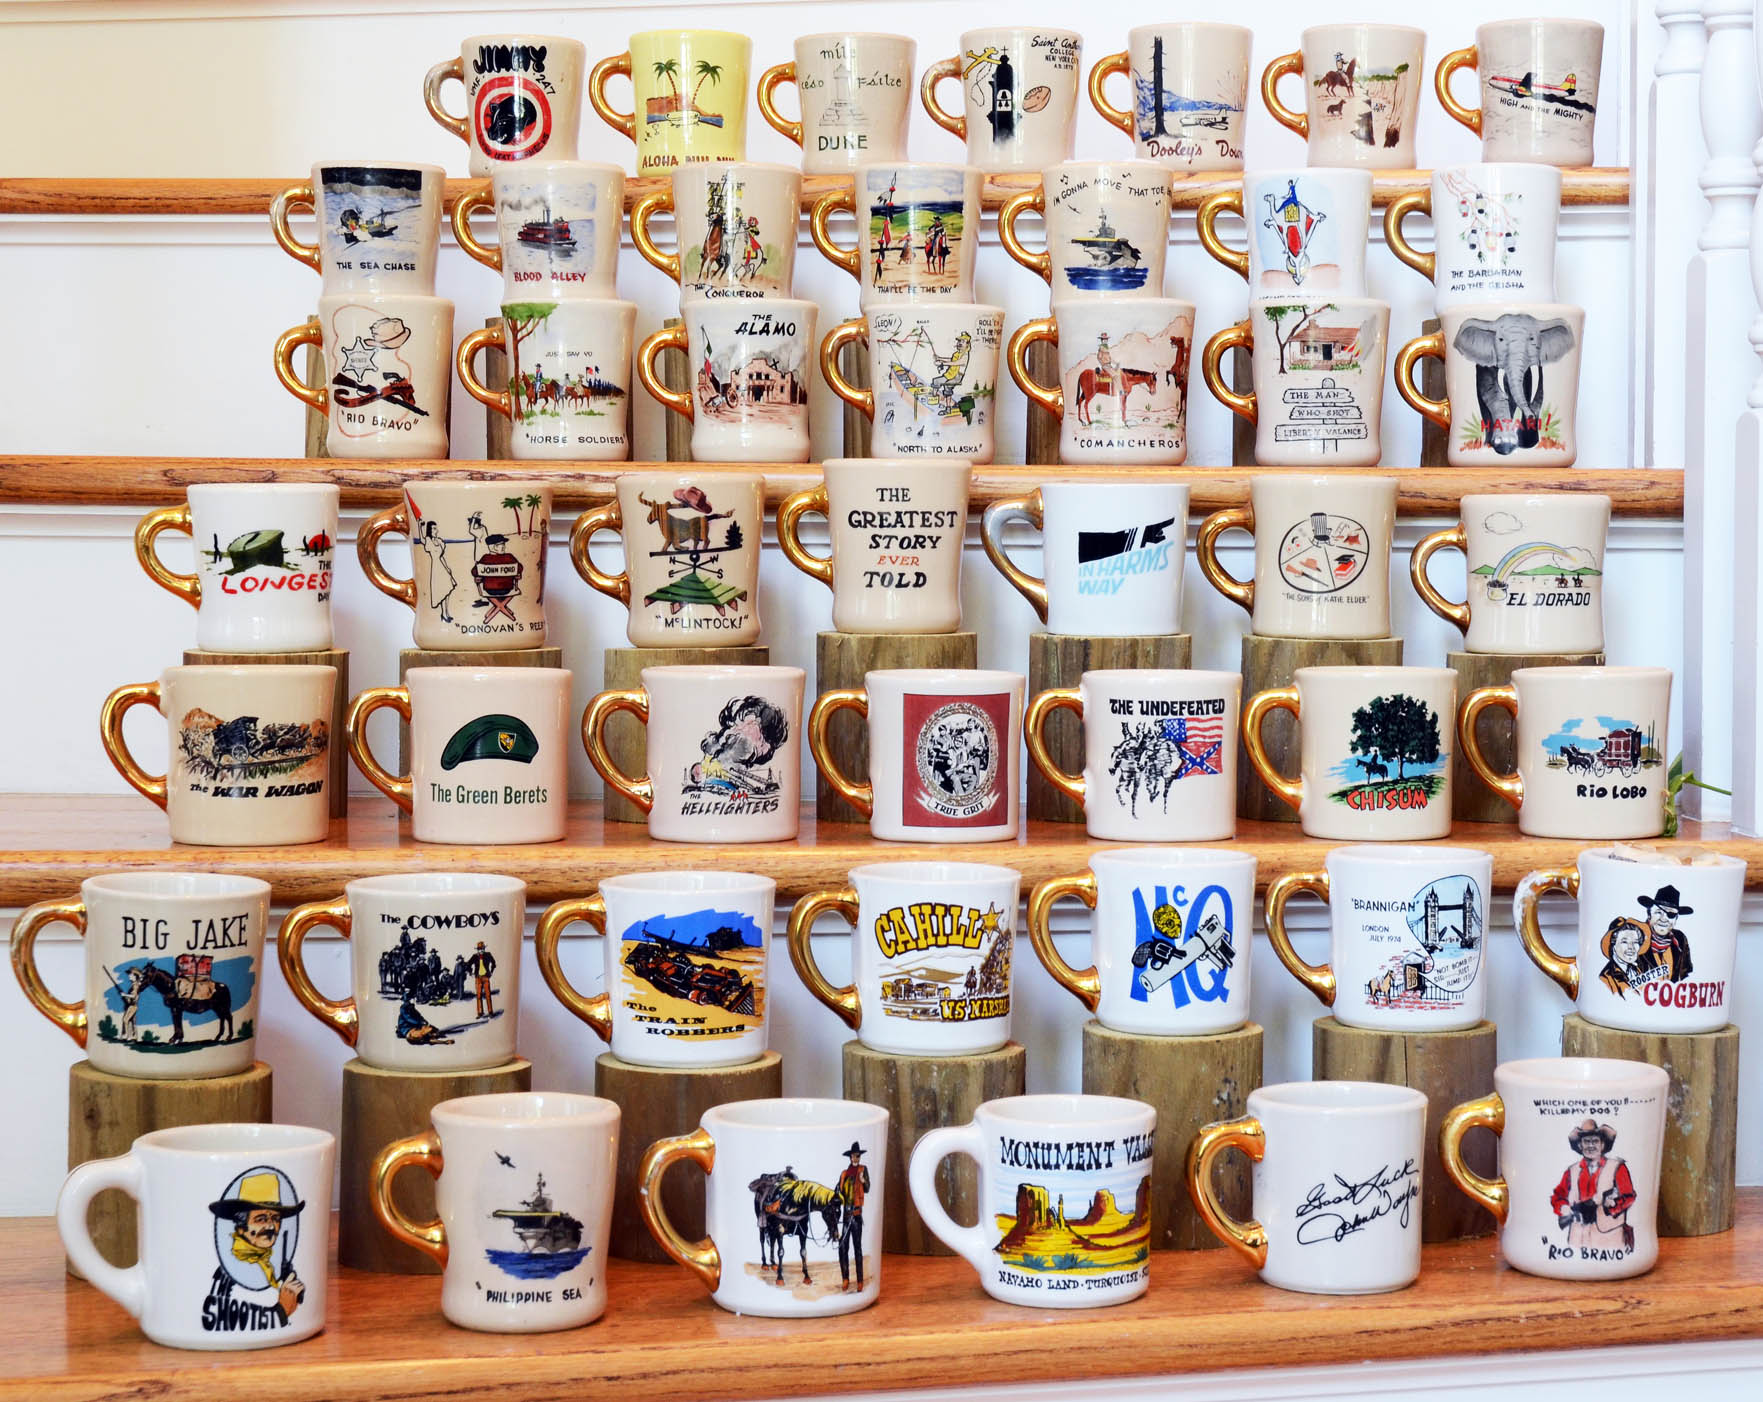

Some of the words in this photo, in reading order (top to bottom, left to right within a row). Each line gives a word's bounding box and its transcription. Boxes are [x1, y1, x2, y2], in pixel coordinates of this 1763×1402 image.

[1031, 35, 1058, 48] Saint
[1500, 97, 1518, 108] HIGH
[1553, 107, 1583, 121] MIGHTY
[818, 135, 868, 151] DUKE
[1147, 140, 1202, 165] Dooley's
[642, 154, 679, 169] ALOHA
[1061, 181, 1088, 200] GONNA
[1094, 178, 1122, 190] MOVE
[1128, 186, 1148, 197] THAT
[337, 262, 352, 270] THE
[360, 262, 380, 270] SEA
[384, 263, 416, 271] CHASE
[1451, 270, 1464, 278] THE
[514, 272, 542, 282] BLOOD
[551, 272, 586, 283] ALLEY
[920, 286, 936, 294] THE
[1467, 282, 1483, 290] THE
[734, 321, 796, 336] ALAMO
[1290, 391, 1309, 399] THE
[1315, 391, 1339, 399] MAN
[1297, 409, 1321, 417] WHO
[1326, 428, 1361, 436] VALANCE
[876, 488, 911, 502] THE
[848, 510, 958, 528] GREATEST
[869, 534, 941, 549] STORY
[877, 555, 920, 566] EVER
[1079, 563, 1094, 576] IN
[863, 571, 927, 588] TOLD
[1079, 577, 1126, 595] WAY
[1506, 592, 1527, 606] EL
[1532, 592, 1591, 606] DORADO
[1109, 698, 1133, 715] THE
[1138, 698, 1225, 716] UNDEFEATED
[212, 786, 259, 798] WAR
[264, 780, 324, 798] WAGON
[430, 783, 451, 802] The
[456, 785, 498, 804] Green
[504, 785, 547, 804] Berets
[1612, 785, 1647, 799] LOBO
[1346, 787, 1428, 811] CHISUM
[681, 799, 779, 816] HELLFIGHTERS
[934, 802, 958, 816] TRUE
[963, 801, 985, 816] GRIT
[380, 913, 401, 924] The
[407, 911, 500, 930] COWBOYS
[122, 916, 170, 950] BIG
[186, 912, 249, 950] JAKE
[874, 902, 984, 959] CAHILL
[1630, 965, 1669, 989] ROOSTER
[1643, 981, 1725, 1009] COGBURN
[626, 1001, 657, 1012] The
[635, 1014, 708, 1025] TRAIN
[646, 1024, 745, 1036] ROBBERS
[1000, 1136, 1115, 1171] MONUMENT
[1296, 1183, 1356, 1217] Good
[1334, 1158, 1420, 1205] Luck
[1297, 1213, 1369, 1245] John
[998, 1270, 1043, 1288] NAVAHO
[201, 1295, 277, 1331] SHOOTIST
